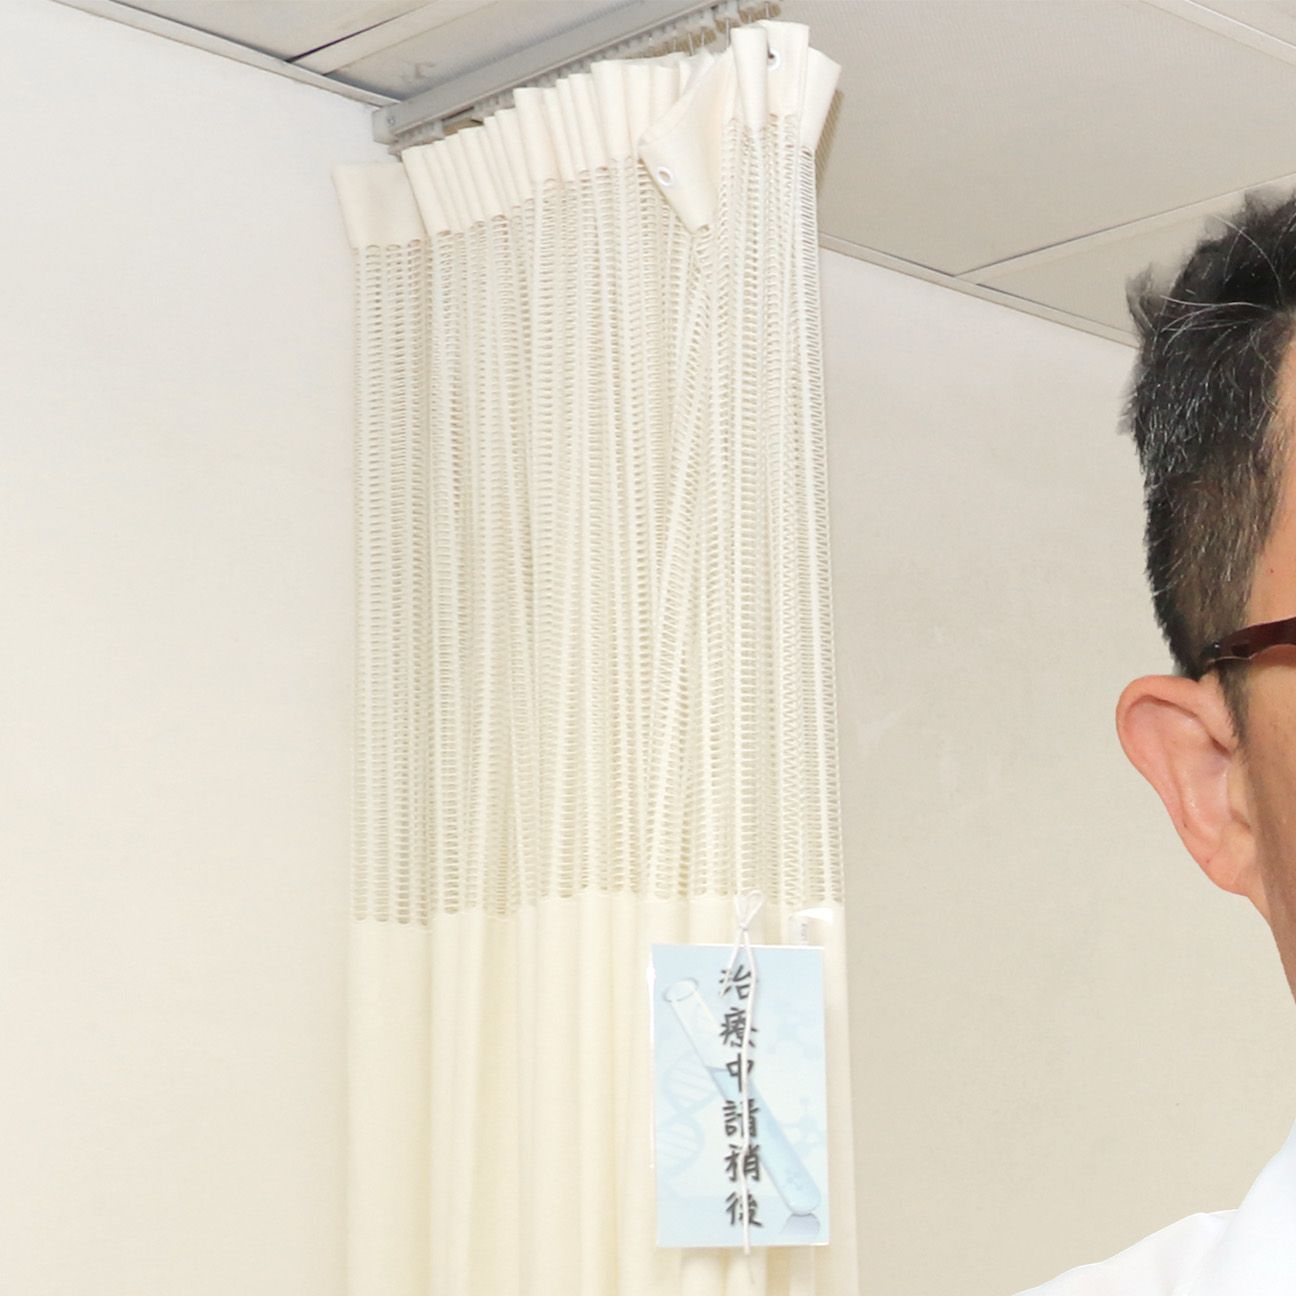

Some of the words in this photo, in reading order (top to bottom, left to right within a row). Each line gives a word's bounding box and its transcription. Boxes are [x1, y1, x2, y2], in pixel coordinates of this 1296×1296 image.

[718, 963, 762, 1228] 治療中請稍後
